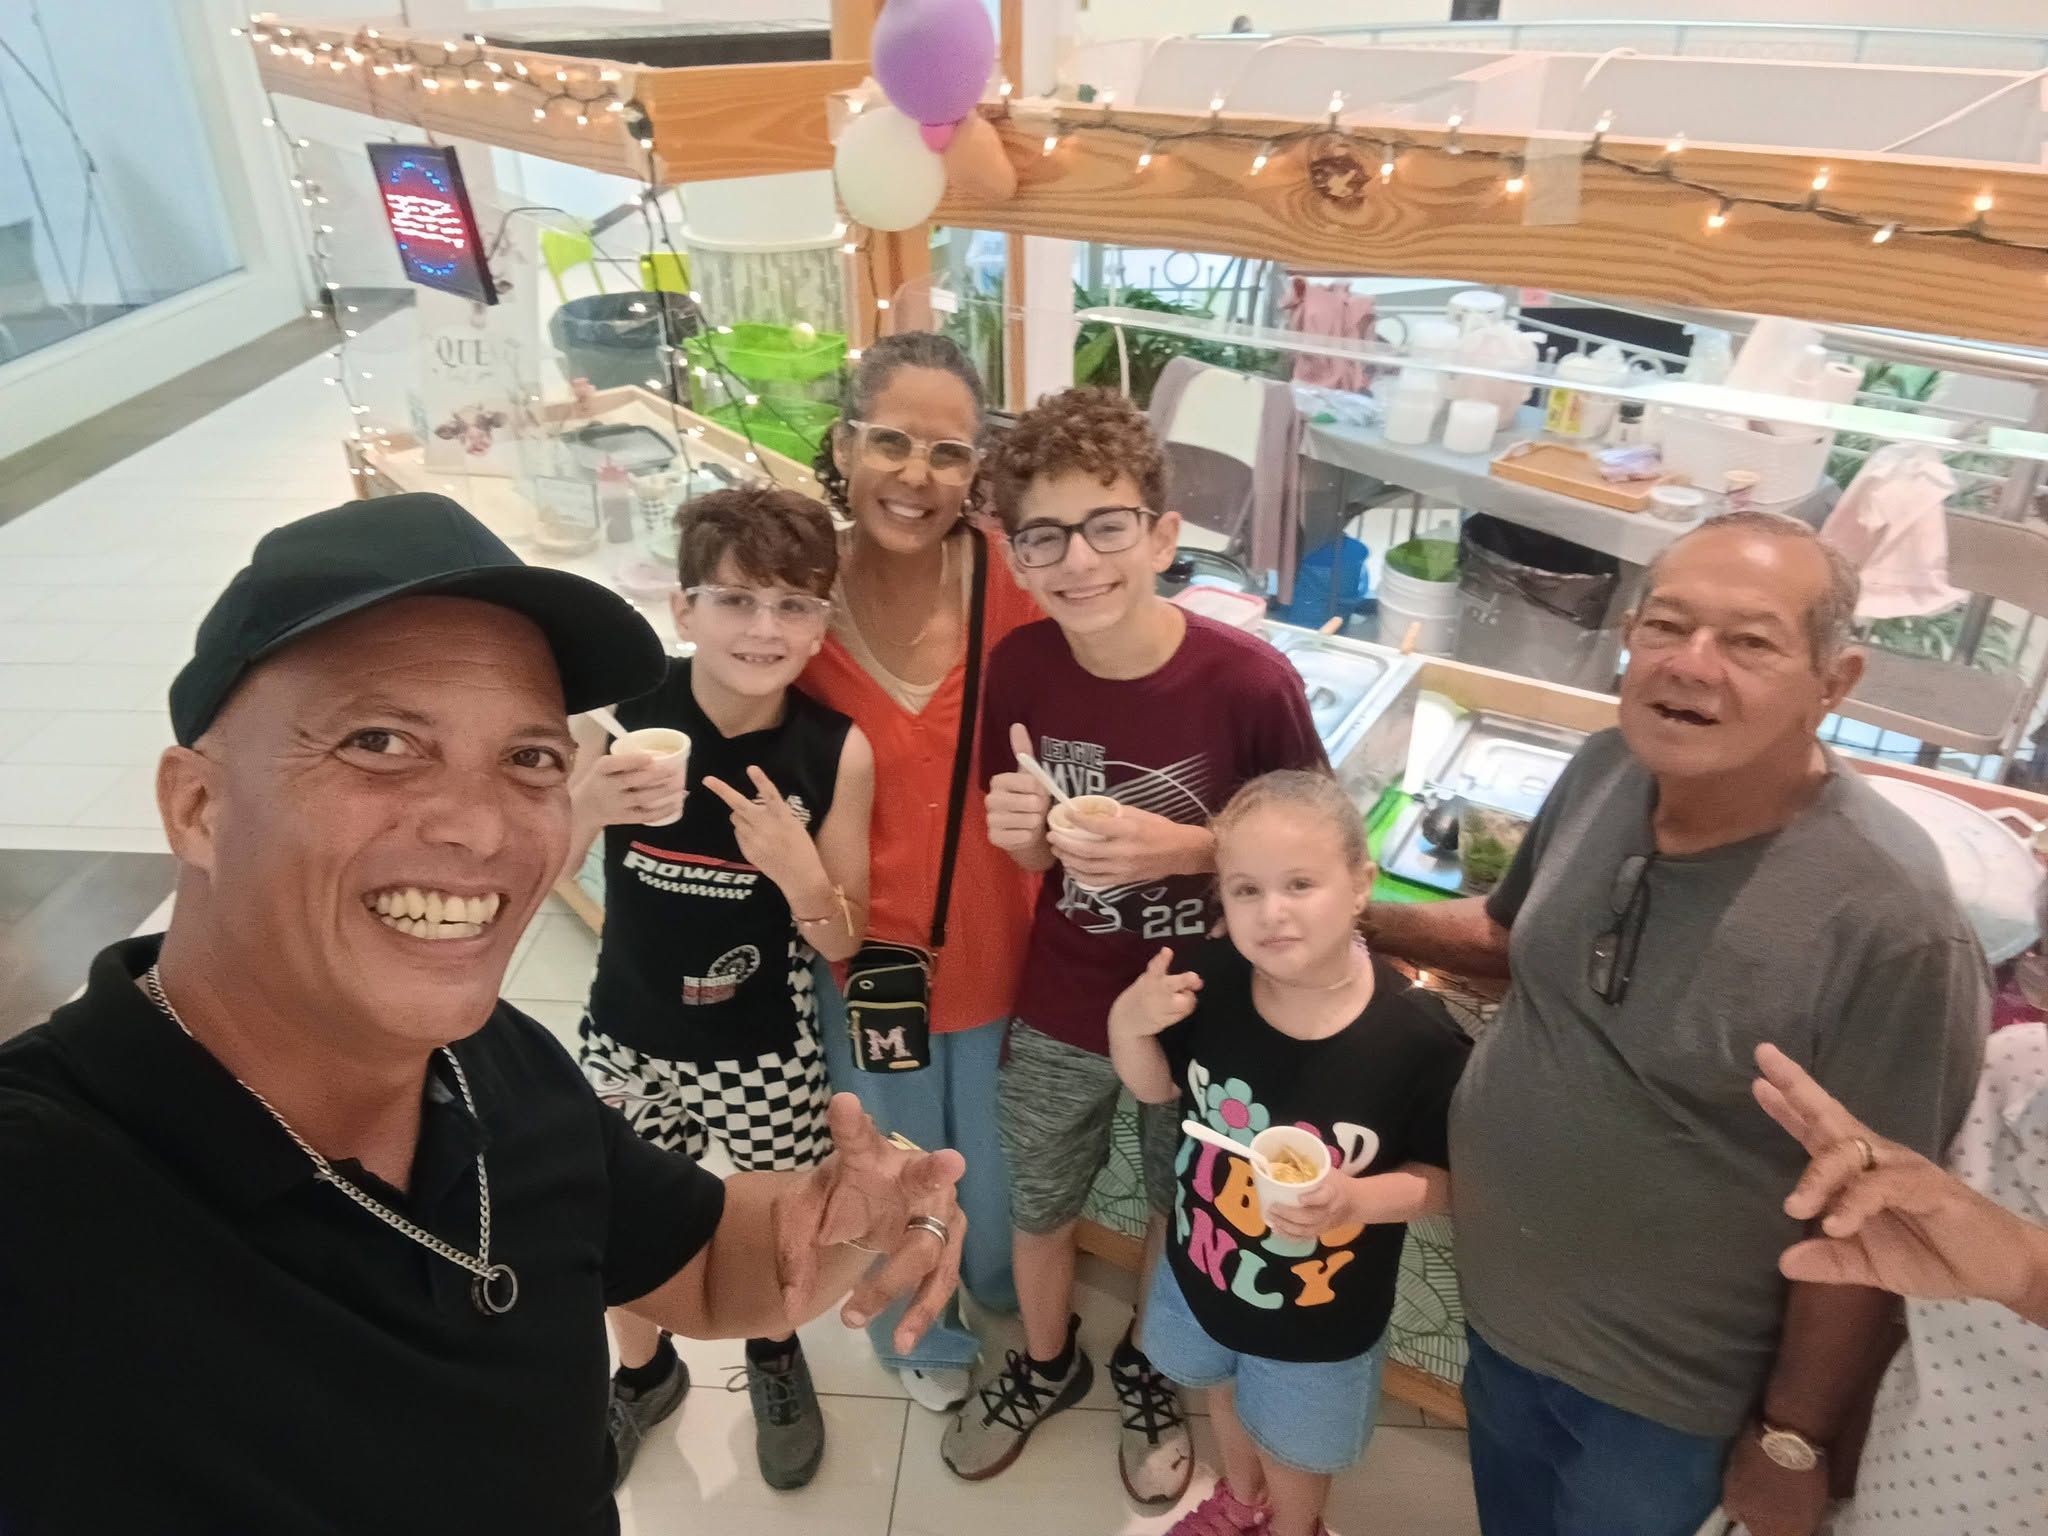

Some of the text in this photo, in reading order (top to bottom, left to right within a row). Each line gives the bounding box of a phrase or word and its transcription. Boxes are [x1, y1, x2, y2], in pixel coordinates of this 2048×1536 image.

[622, 850, 760, 886] POWER
[1142, 899, 1205, 939] 22
[865, 1026, 913, 1061] M
